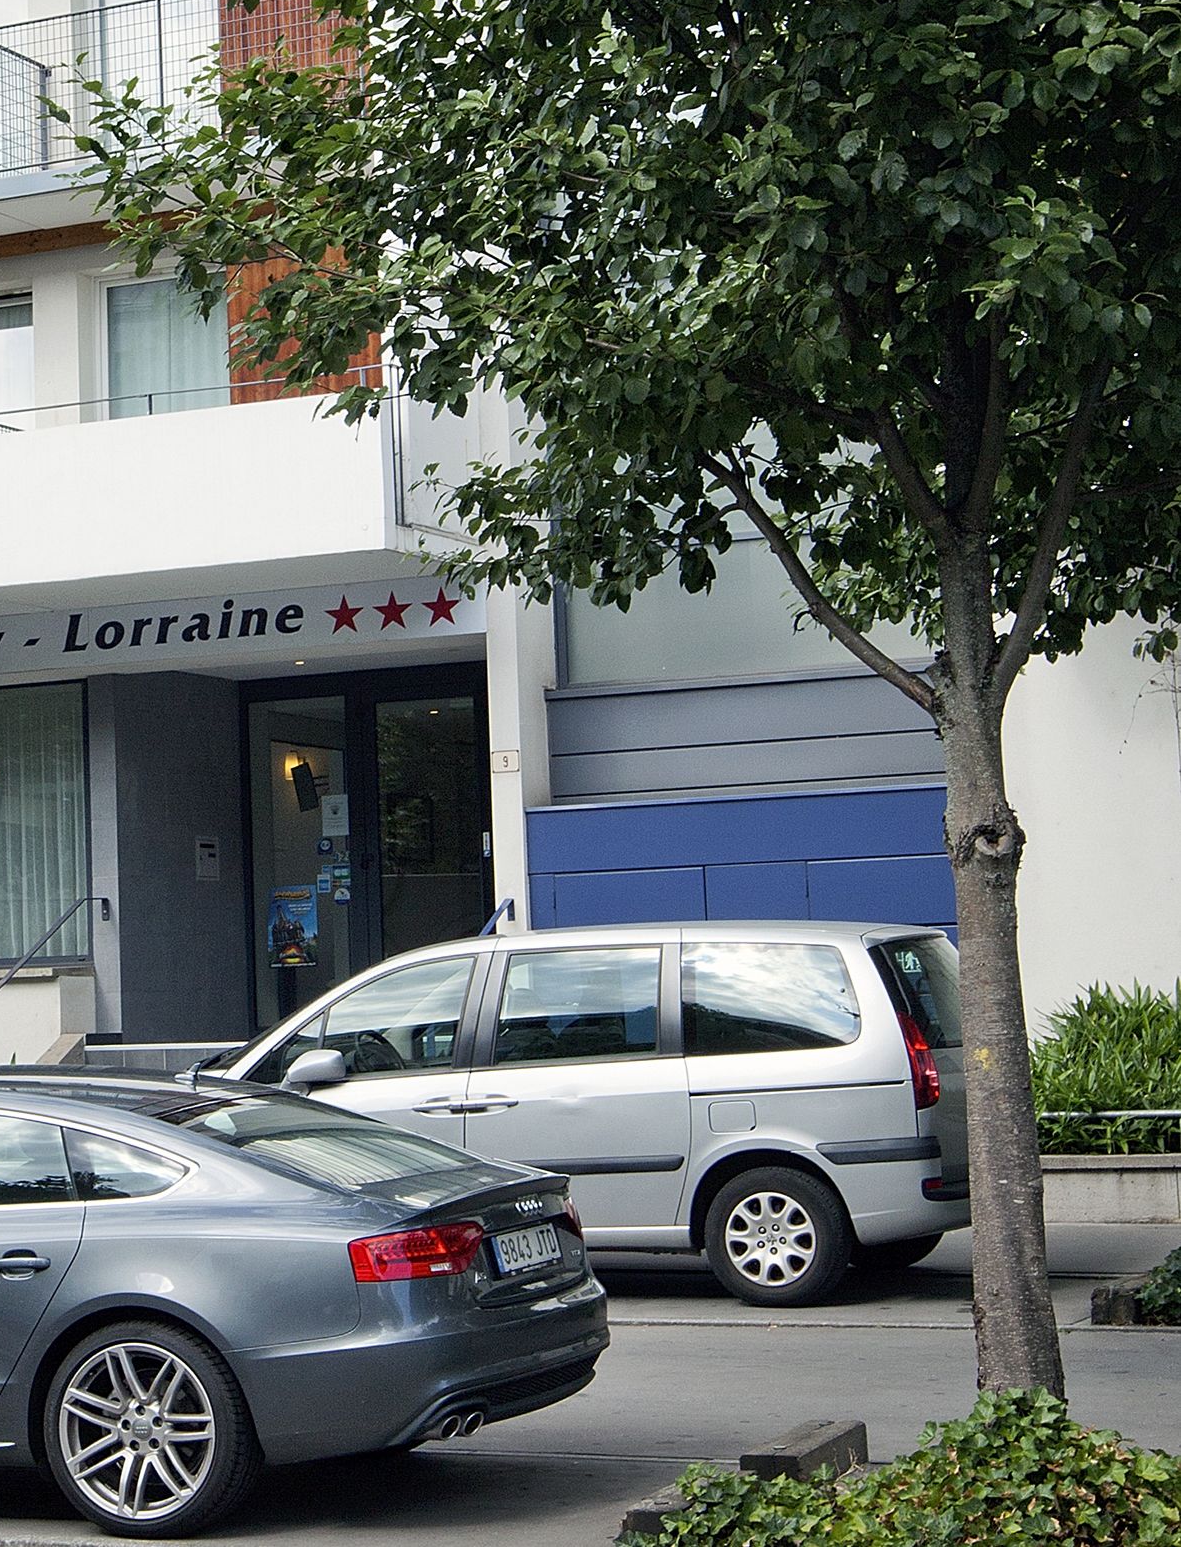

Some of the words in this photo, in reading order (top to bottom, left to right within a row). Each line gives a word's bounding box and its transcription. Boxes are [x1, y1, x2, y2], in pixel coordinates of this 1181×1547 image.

[62, 599, 305, 653] Lorraine
[502, 755, 509, 768] 9
[500, 1234, 533, 1265] 9843
